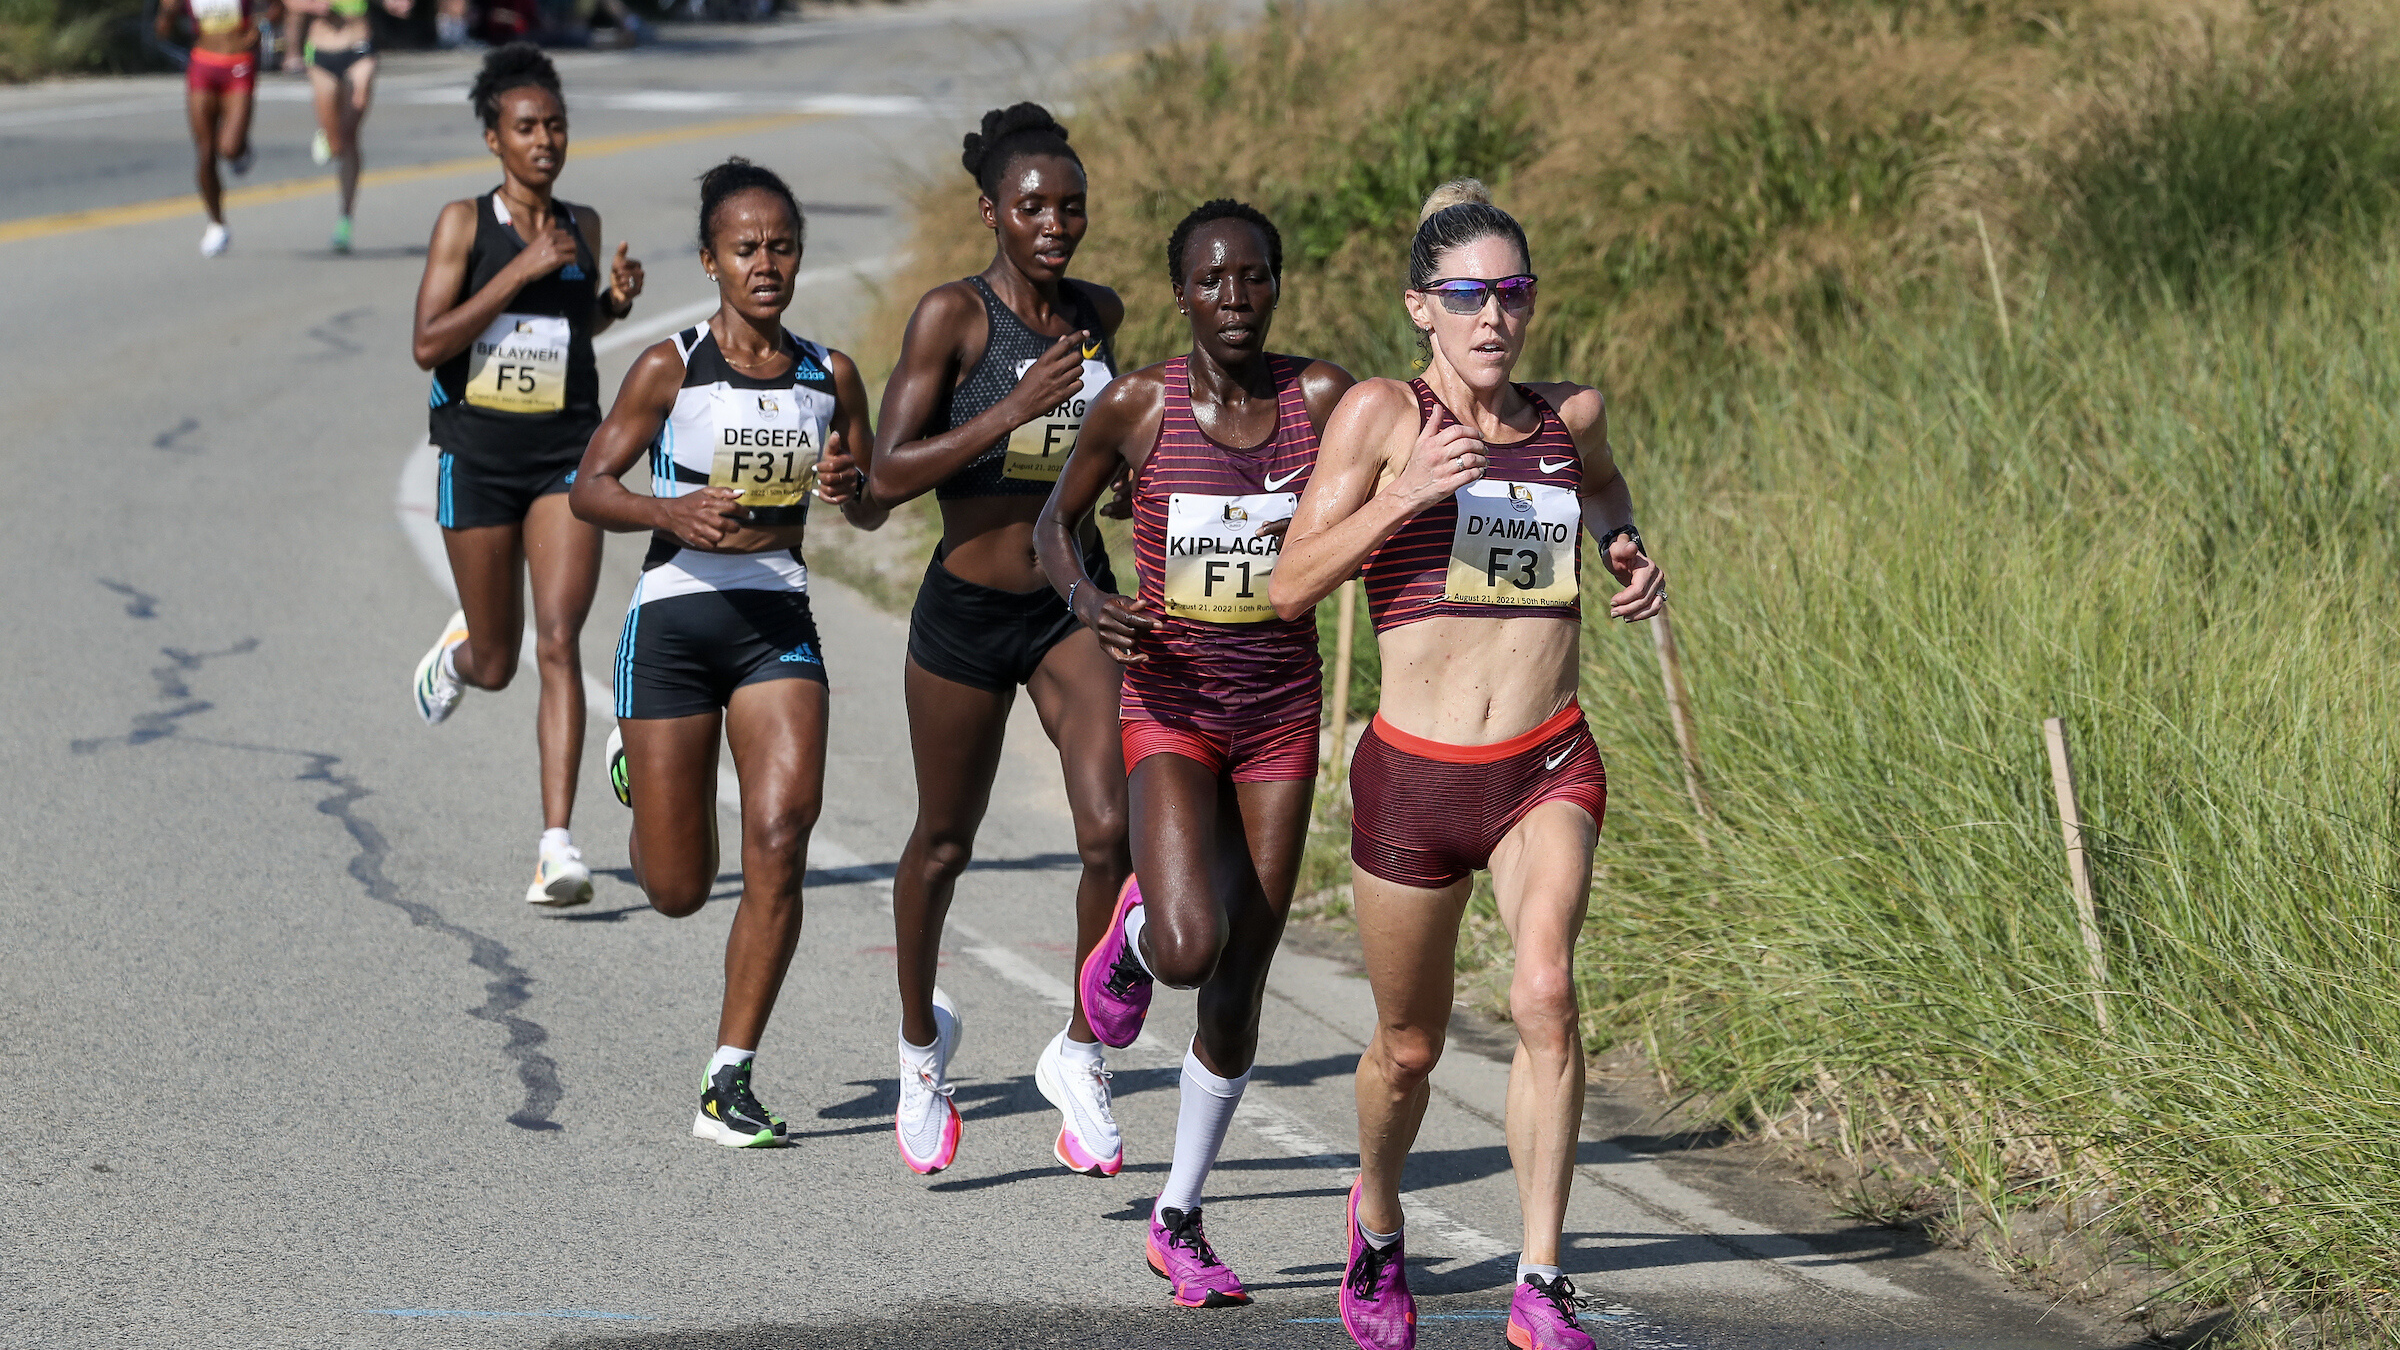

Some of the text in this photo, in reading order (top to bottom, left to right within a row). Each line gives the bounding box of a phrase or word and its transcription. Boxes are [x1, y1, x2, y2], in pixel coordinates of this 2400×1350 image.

[477, 341, 559, 361] BELAYNEH
[496, 363, 536, 393] F5
[795, 369, 826, 381] adidas
[724, 427, 812, 448] DEGEFA
[1041, 423, 1081, 458] F7
[730, 451, 795, 484] F31
[1204, 561, 1254, 599] F1
[1487, 546, 1539, 590] F3
[1198, 604, 1211, 613] 21,
[1212, 604, 1232, 613] 2022
[1238, 604, 1255, 613] 50th
[1453, 592, 1479, 604] August
[1481, 594, 1494, 604] 21,
[1496, 596, 1515, 605] 2022
[1521, 597, 1539, 606] 50th
